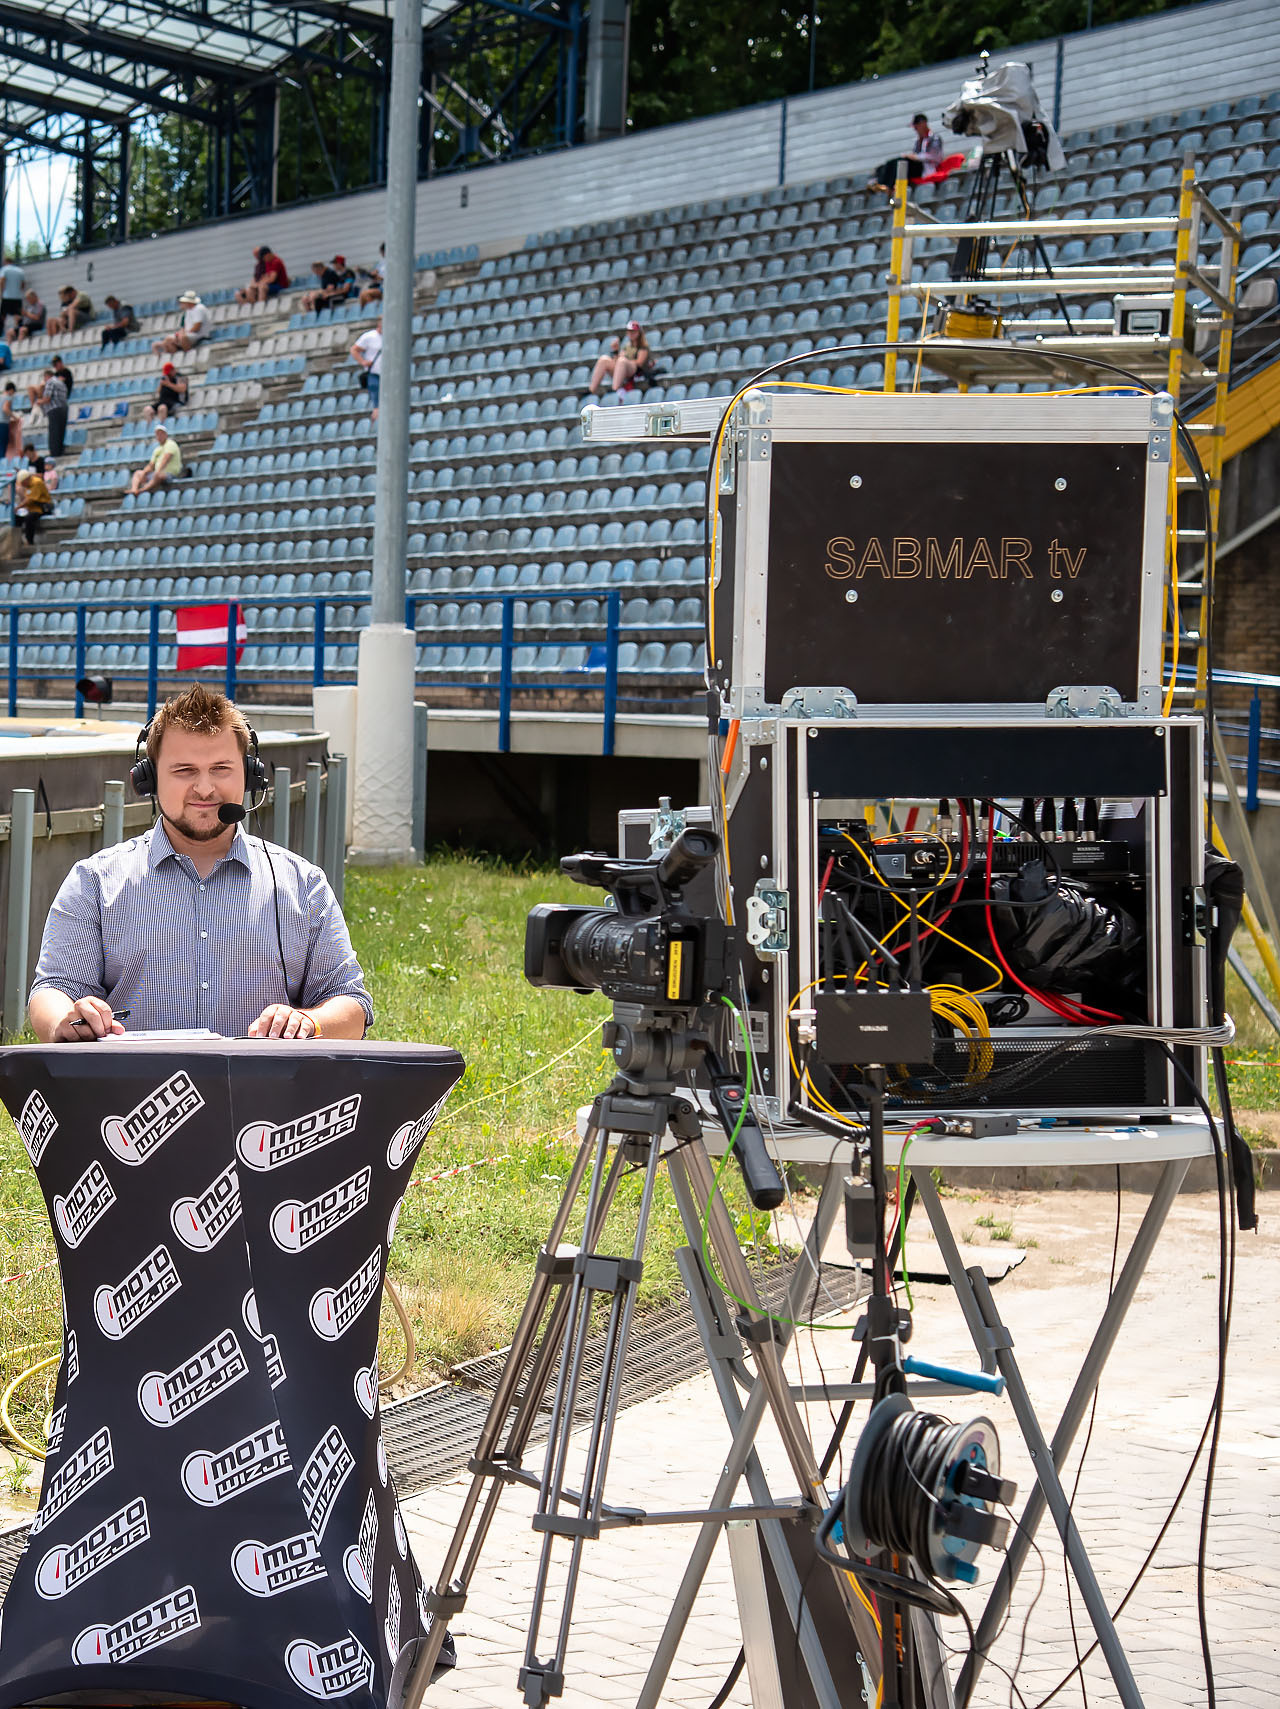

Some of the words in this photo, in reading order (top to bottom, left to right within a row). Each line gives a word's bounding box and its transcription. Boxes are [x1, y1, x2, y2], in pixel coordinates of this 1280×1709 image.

[824, 537, 1033, 580] SABMAR
[1048, 538, 1087, 579] tv
[22, 1092, 45, 1141] MOTO
[32, 1115, 54, 1158] WIZJA
[123, 1074, 190, 1140] MOTO
[136, 1093, 199, 1155] WIZJA
[270, 1097, 359, 1148] MOTO
[271, 1117, 354, 1163] WIZJA
[65, 1164, 105, 1223] MOTO
[72, 1186, 112, 1240] WIZJA
[299, 1168, 370, 1229] MOTO
[300, 1190, 367, 1244] WIZJA
[113, 1248, 170, 1313] MOTO
[120, 1272, 176, 1329] WIZJA
[333, 1249, 380, 1316] MOTO
[164, 1333, 237, 1401] MOTO
[170, 1358, 243, 1416] WIZJA
[43, 1455, 110, 1522] WIZJA
[310, 1449, 352, 1532] WIZJA
[65, 1499, 145, 1571] MOTO
[67, 1524, 147, 1586] WIZJA
[106, 1588, 194, 1650] MOTO
[111, 1611, 195, 1663] WIZJA
